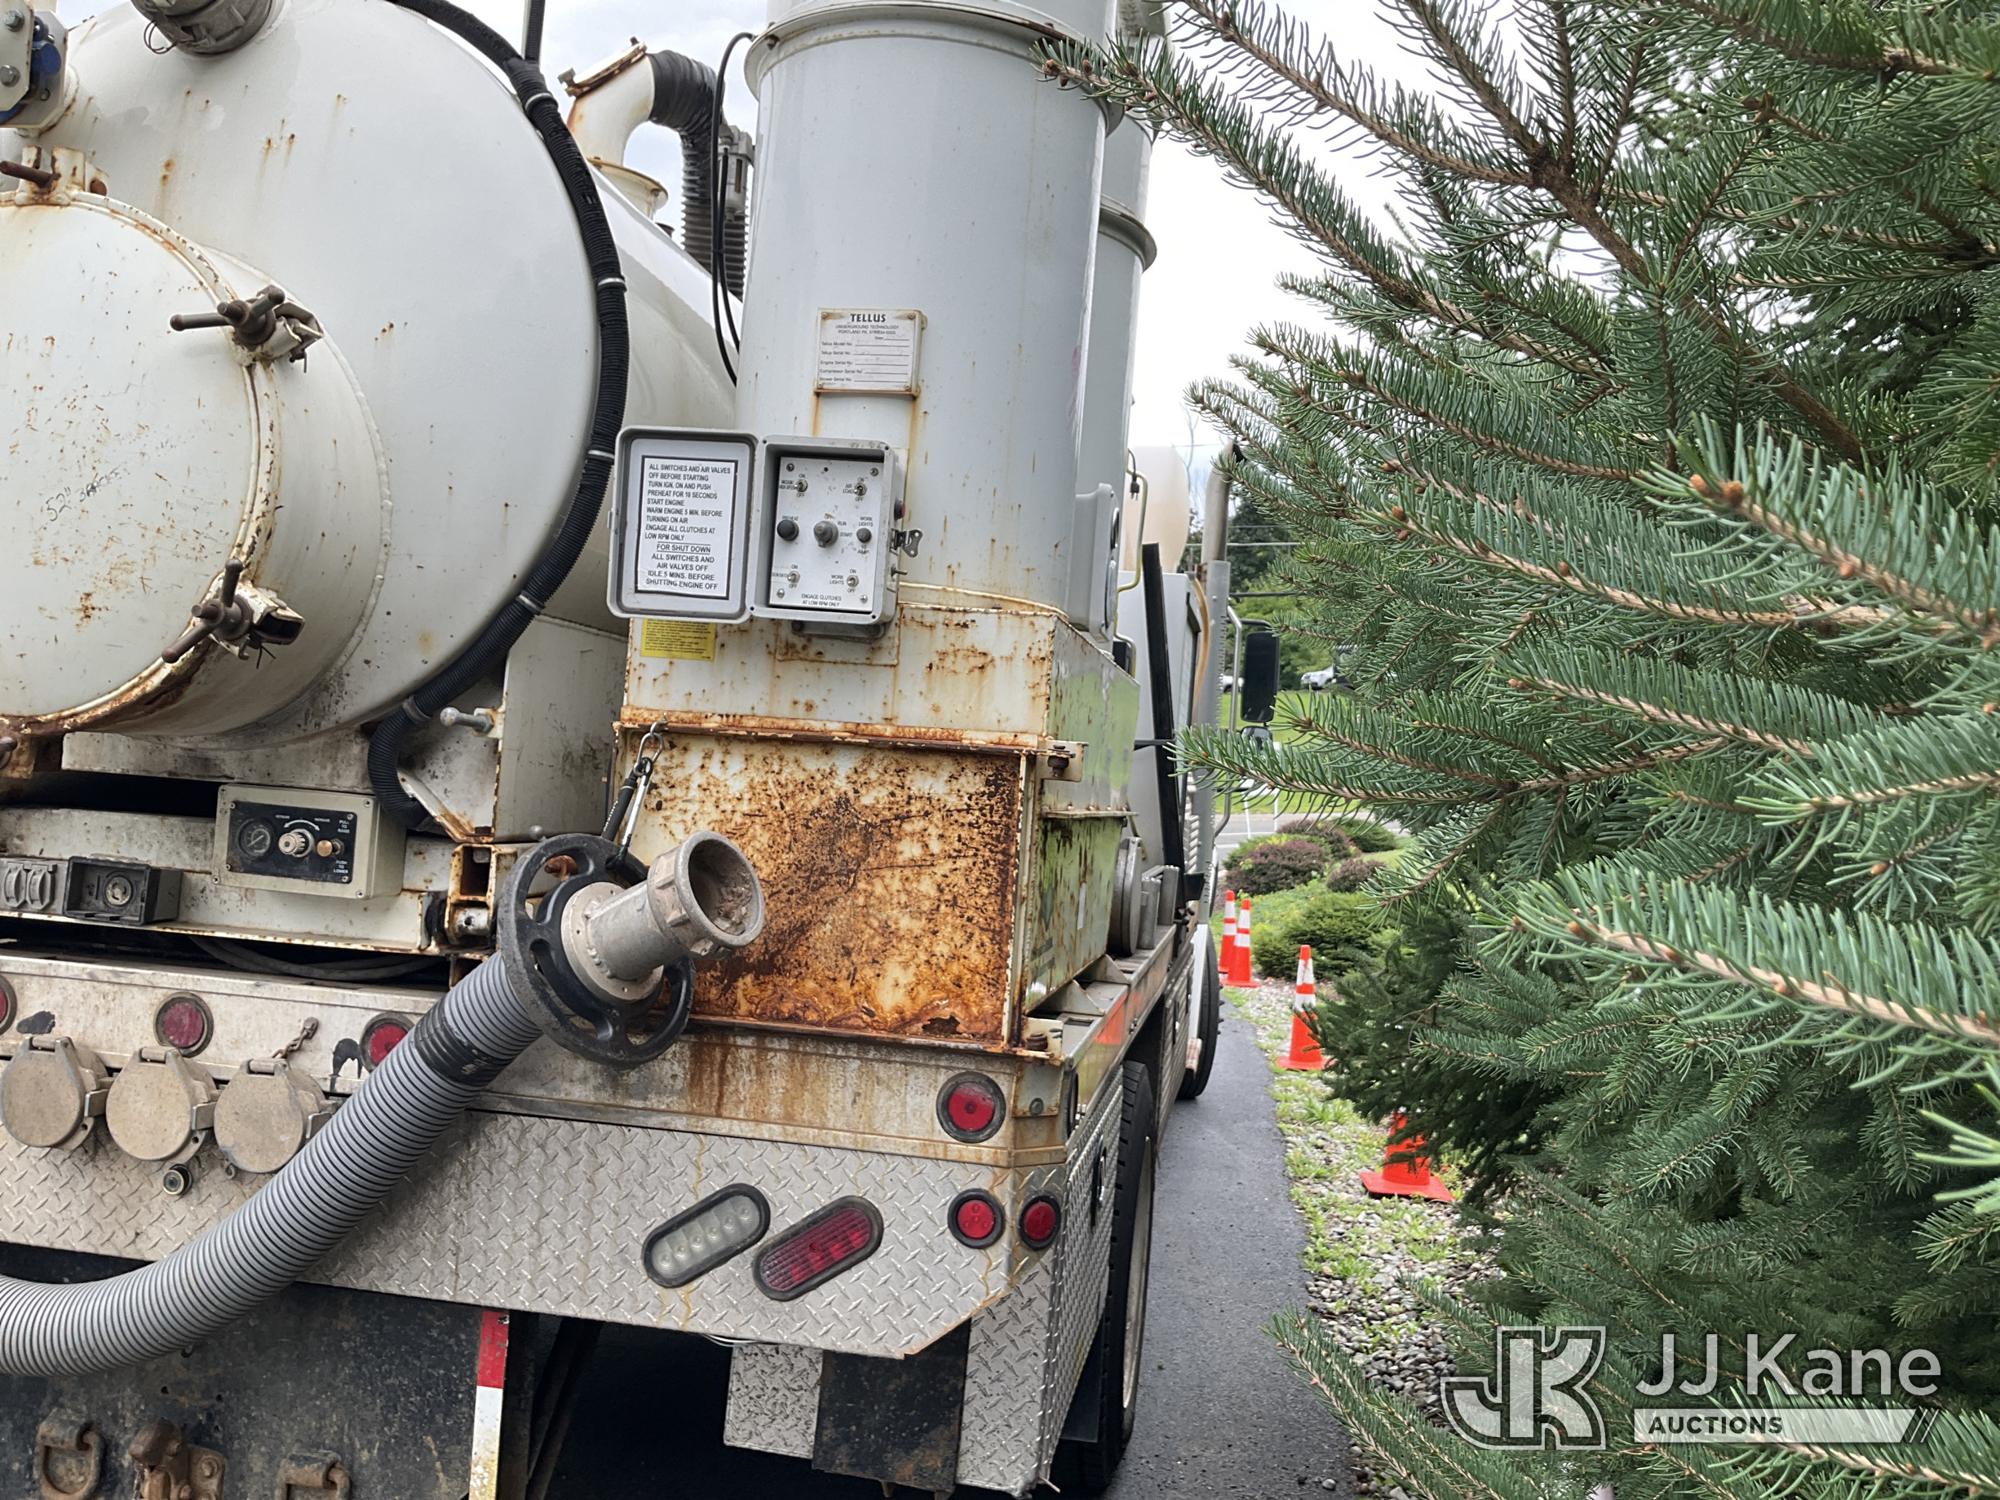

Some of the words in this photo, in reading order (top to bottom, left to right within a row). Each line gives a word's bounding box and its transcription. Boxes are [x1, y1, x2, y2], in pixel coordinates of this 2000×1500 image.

[850, 314, 886, 322] TELLUS
[666, 554, 699, 562] SWITCHES
[679, 580, 703, 588] ENGINE
